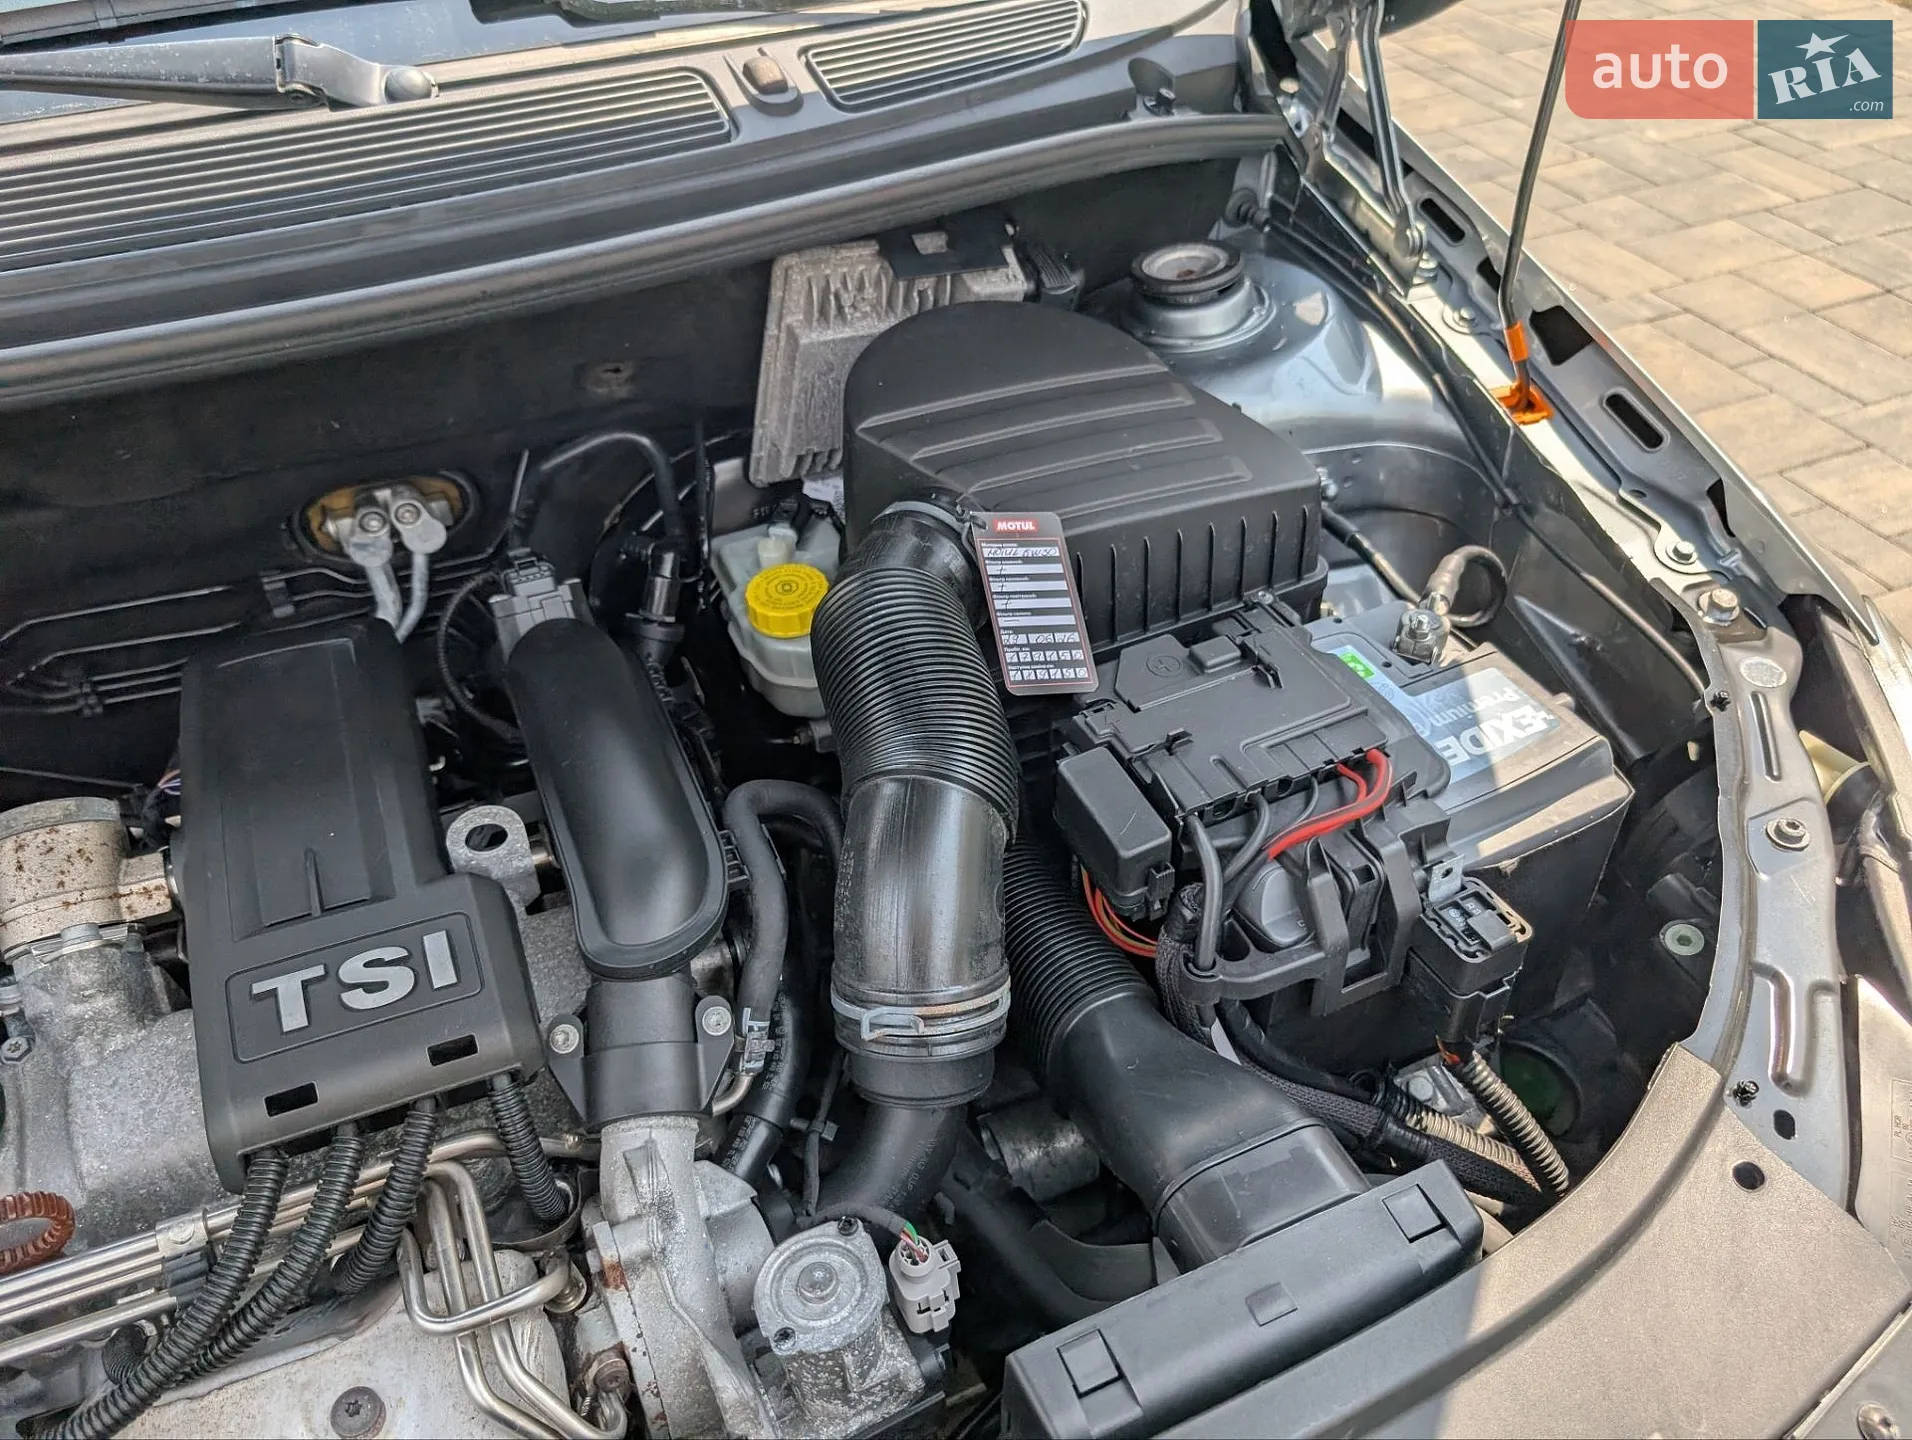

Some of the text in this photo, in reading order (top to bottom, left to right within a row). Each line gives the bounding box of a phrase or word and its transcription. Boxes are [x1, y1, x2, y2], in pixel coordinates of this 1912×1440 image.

[997, 521, 1035, 531] MOTUL
[1431, 688, 1520, 727] Premium
[1437, 705, 1549, 766] EXIDE
[252, 930, 457, 1032] TSI
